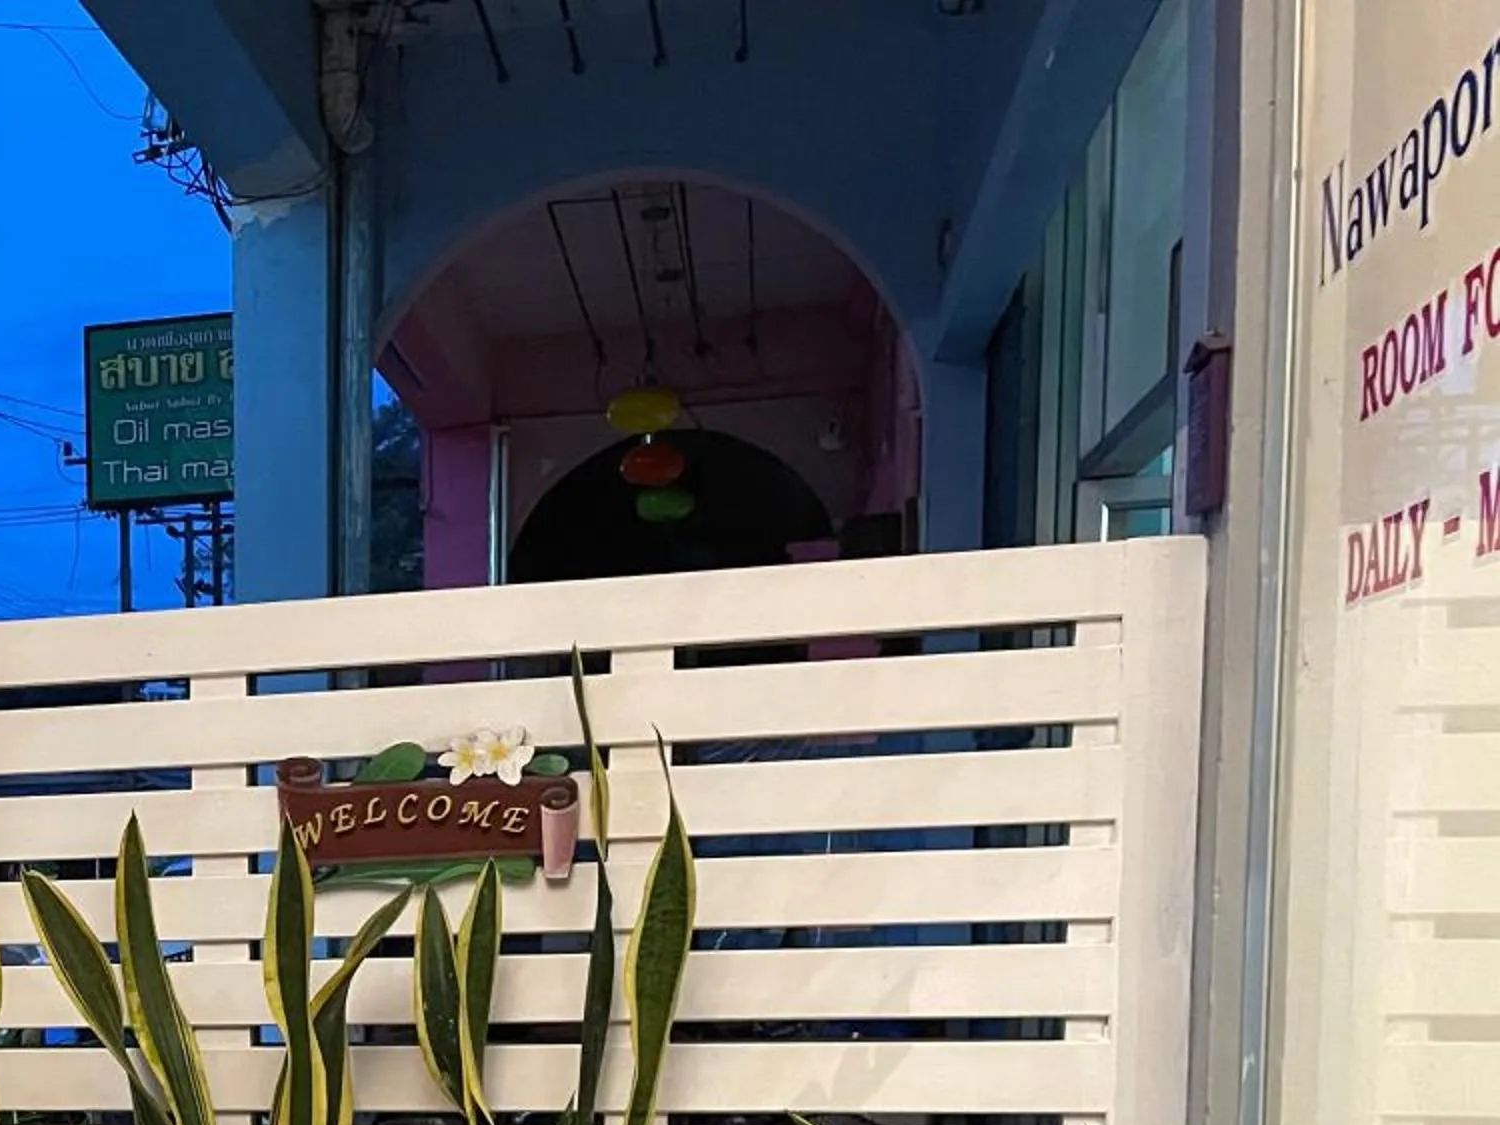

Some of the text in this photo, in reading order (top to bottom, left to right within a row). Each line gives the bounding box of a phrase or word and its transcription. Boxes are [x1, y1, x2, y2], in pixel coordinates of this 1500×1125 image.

[100, 351, 204, 389] สบาย
[1360, 290, 1448, 421] ROOM
[113, 418, 231, 445] Oil mas
[102, 459, 234, 484] Thai ma
[1345, 500, 1430, 605] DAILY
[296, 794, 530, 850] WELCOME
